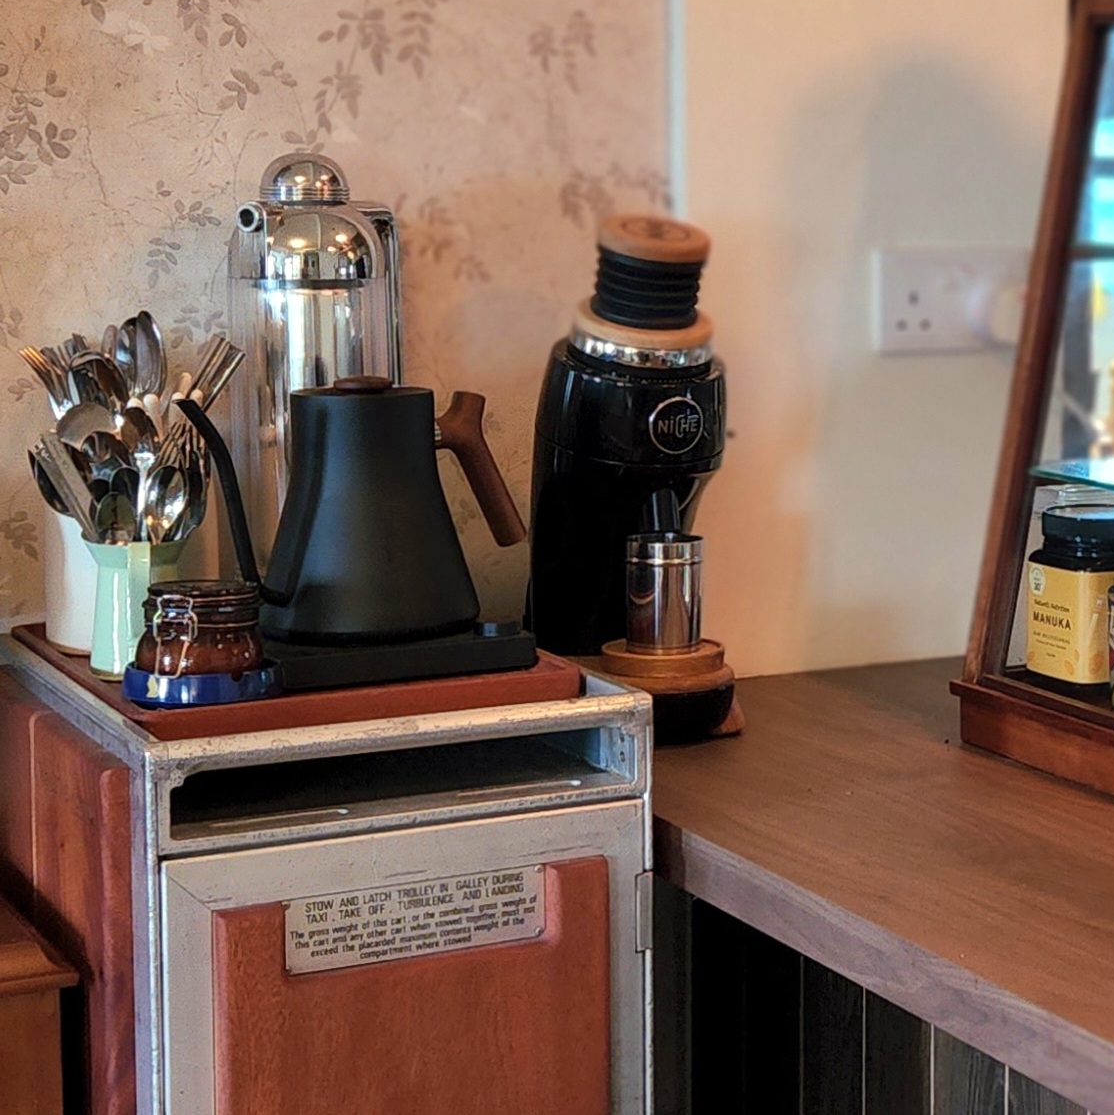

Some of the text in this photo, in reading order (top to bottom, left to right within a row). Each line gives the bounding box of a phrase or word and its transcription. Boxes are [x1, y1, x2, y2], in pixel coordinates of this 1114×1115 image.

[1033, 610, 1072, 631] MANUKA
[305, 872, 524, 913] STOW AND LATCH TROLLEY IN GALLEY DURING
[338, 908, 362, 920] TAKE
[398, 894, 454, 911] TURBULENCE
[462, 890, 482, 901] AND
[485, 883, 524, 898] LANDING
[290, 930, 305, 940] The
[308, 928, 329, 939] gross
[332, 923, 358, 934] weight
[362, 921, 370, 930] of
[373, 917, 387, 926] this
[412, 914, 420, 922] or
[423, 911, 435, 920] the
[295, 941, 310, 949] this
[313, 938, 329, 947] cart
[332, 935, 347, 944] and
[350, 933, 364, 942] any
[366, 929, 387, 939] other
[390, 926, 406, 935] cart
[523, 906, 536, 914] not
[310, 946, 338, 958] exceed
[342, 944, 355, 953] the
[359, 937, 396, 951] placarded
[513, 917, 525, 926] the
[360, 934, 472, 960] compartment where stowed
